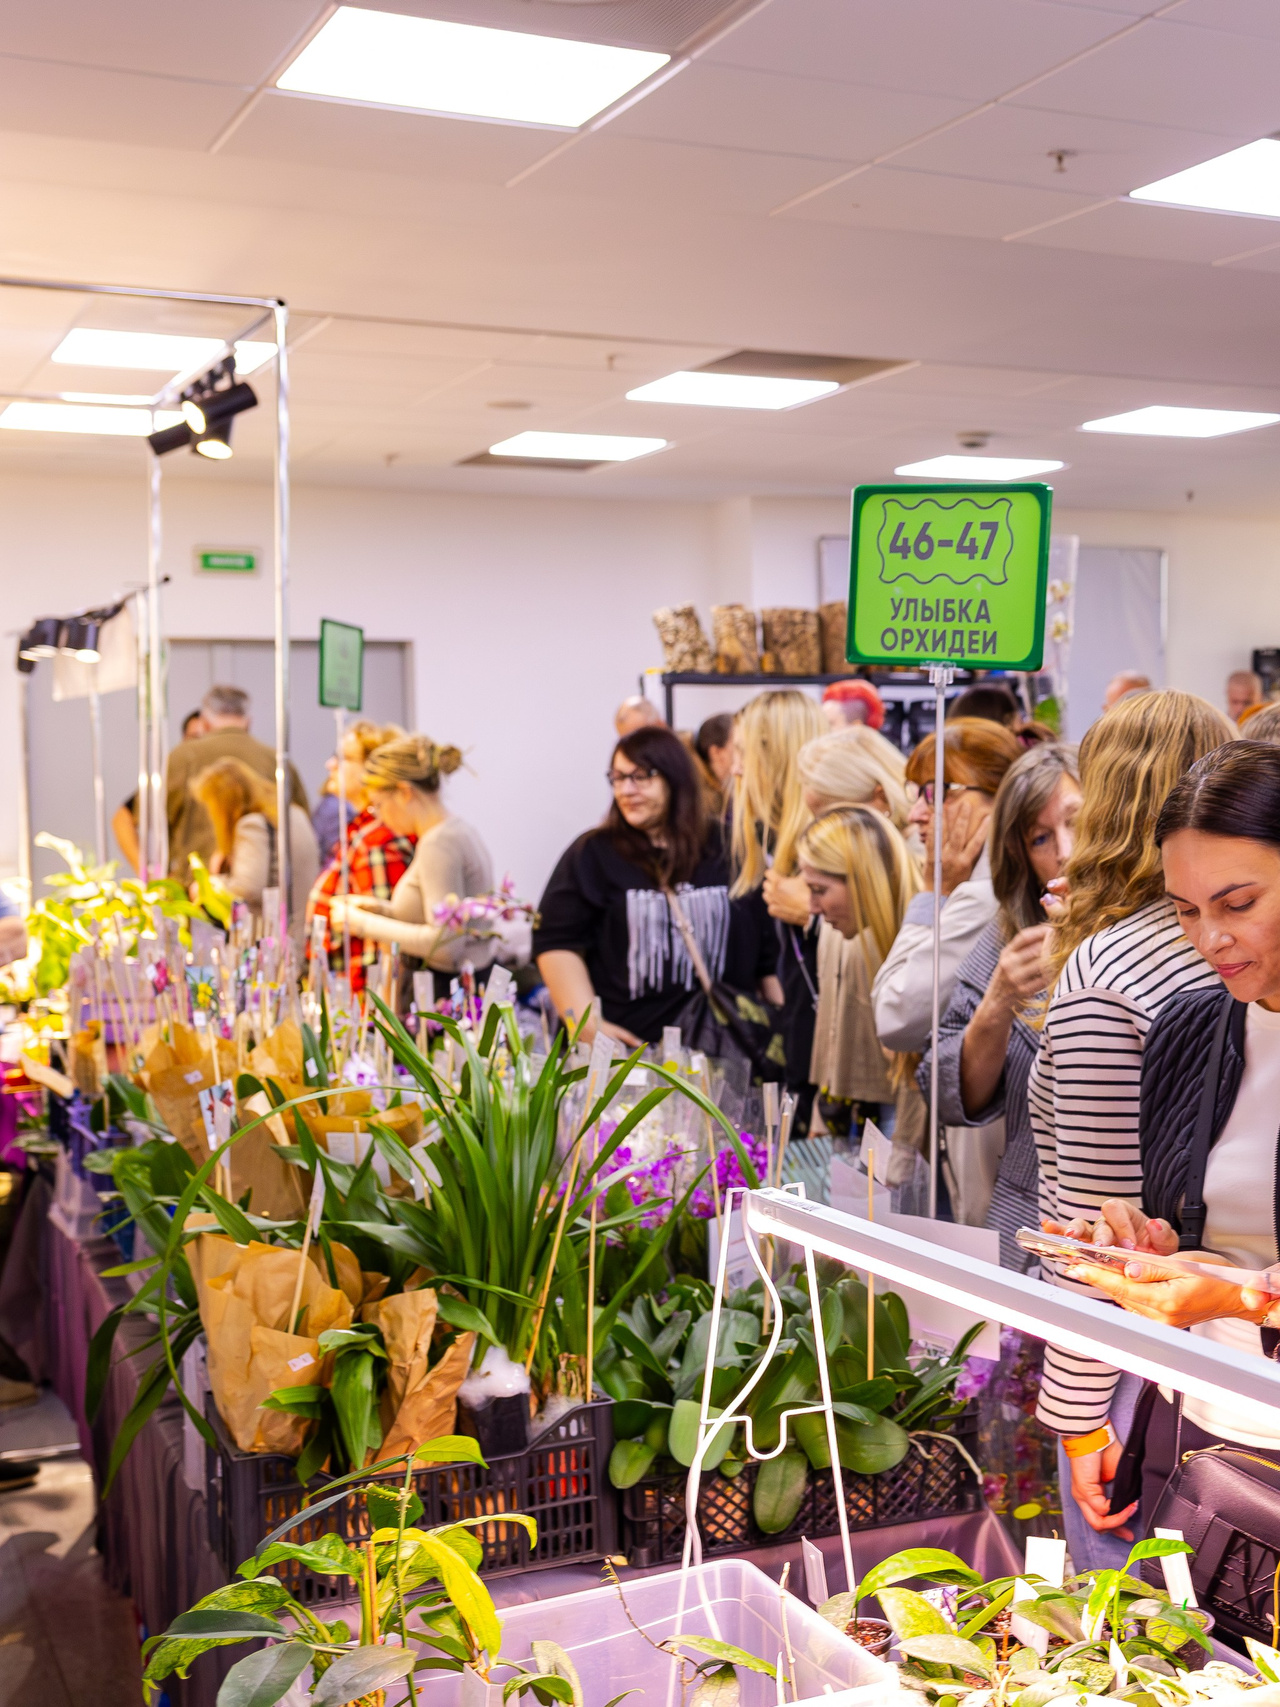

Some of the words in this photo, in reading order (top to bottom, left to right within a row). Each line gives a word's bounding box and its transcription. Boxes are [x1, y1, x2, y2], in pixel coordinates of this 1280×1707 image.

[888, 521, 999, 561] 46-47
[890, 597, 991, 624] УЛЫБКА
[880, 627, 998, 658] ОРХИДЕИ
